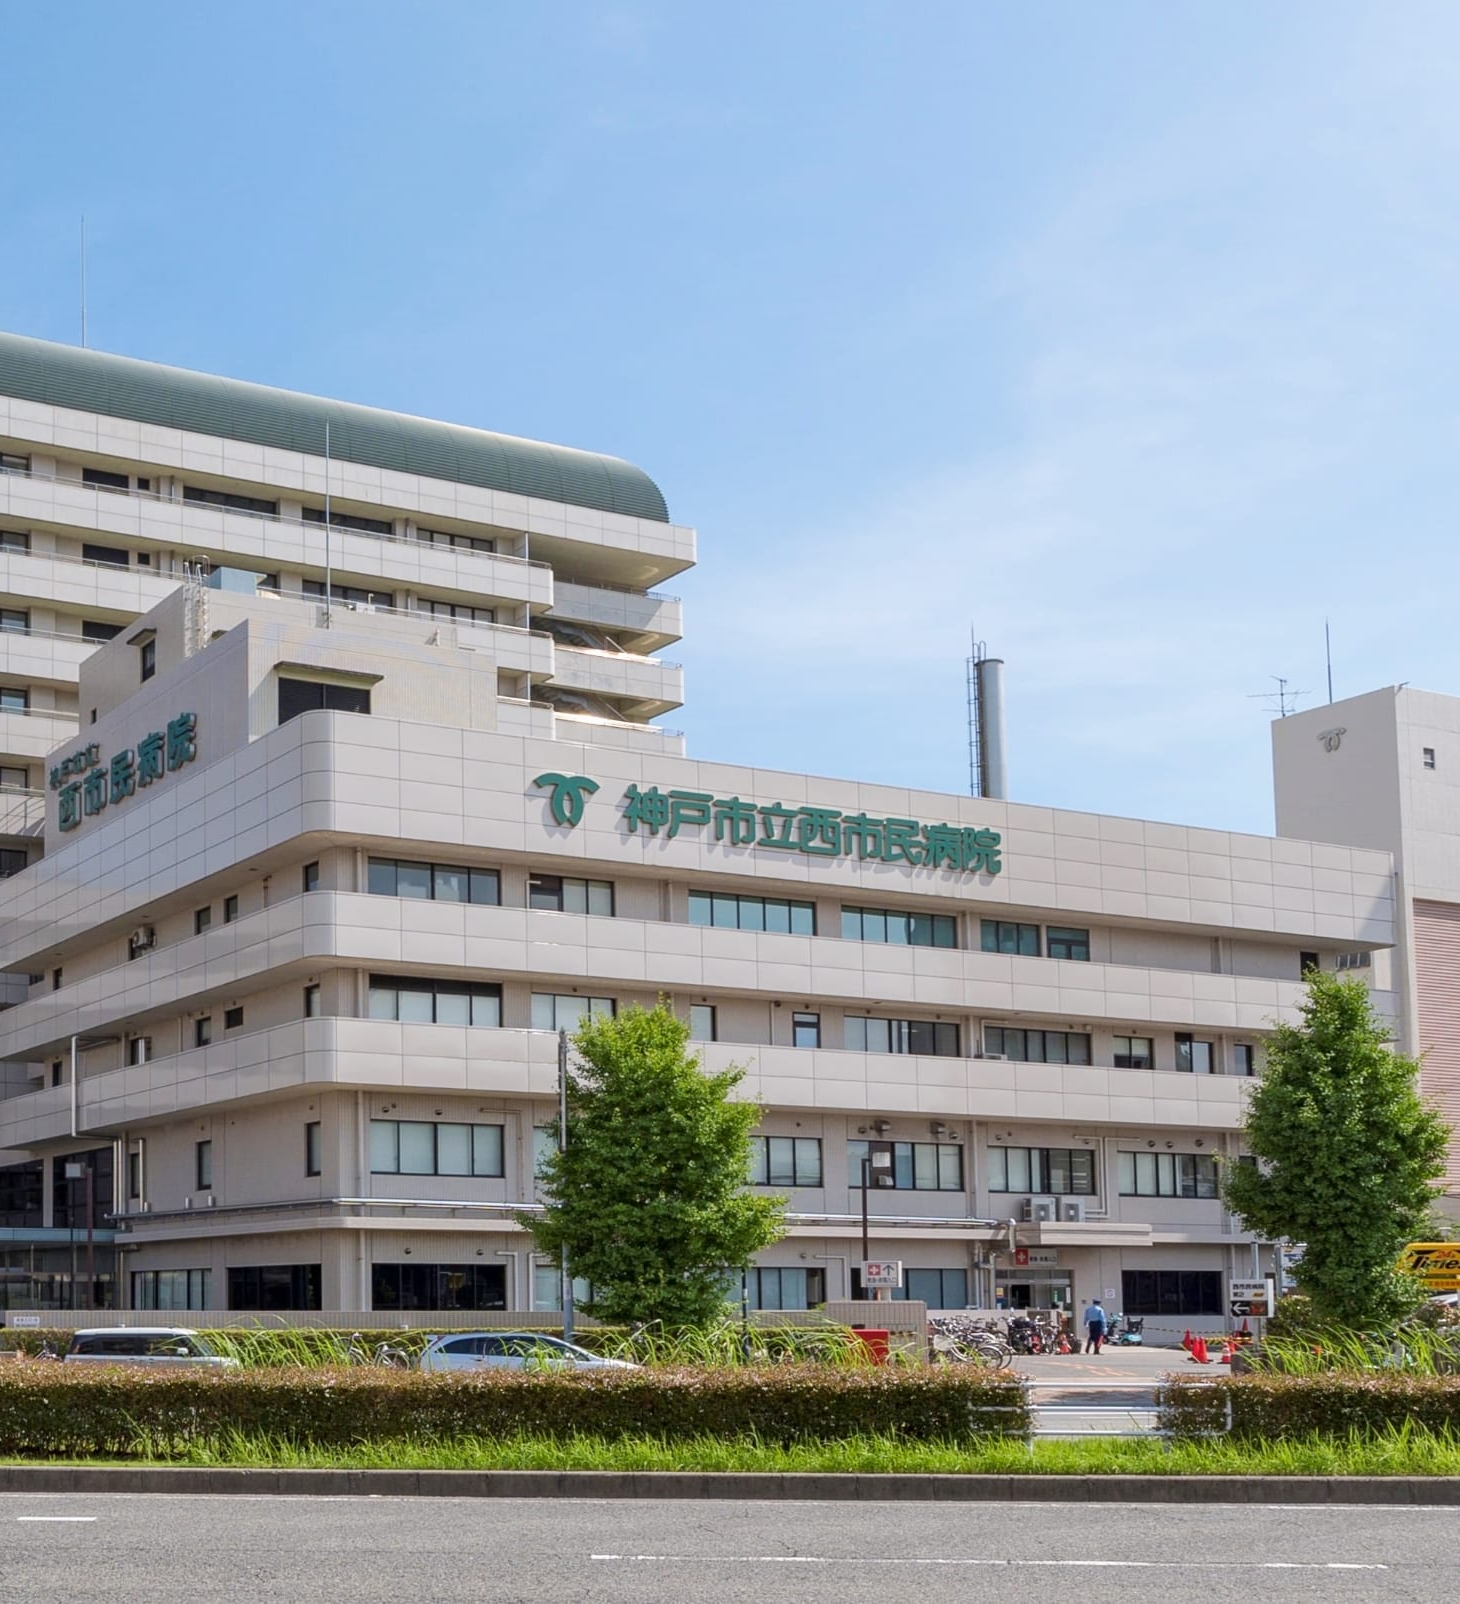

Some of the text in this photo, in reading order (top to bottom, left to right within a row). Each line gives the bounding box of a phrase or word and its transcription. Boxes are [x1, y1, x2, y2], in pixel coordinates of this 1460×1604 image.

[57, 712, 197, 833] 西市民病院
[623, 783, 1003, 875] 神戸市立西市民病院
[1411, 1254, 1460, 1269] Tie
